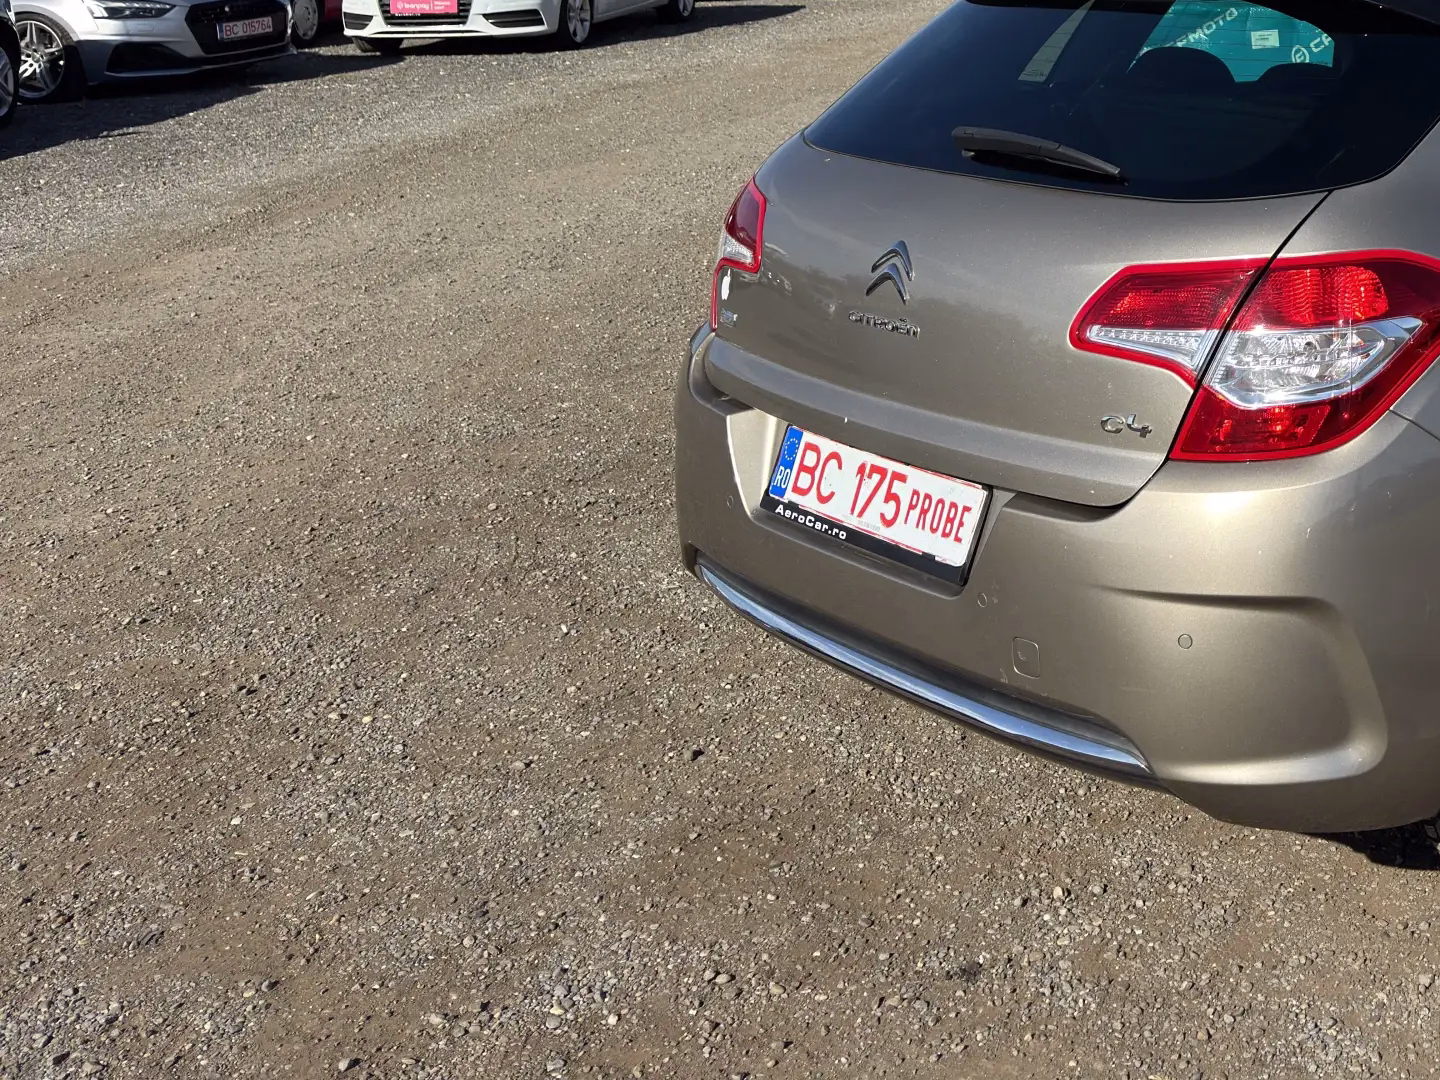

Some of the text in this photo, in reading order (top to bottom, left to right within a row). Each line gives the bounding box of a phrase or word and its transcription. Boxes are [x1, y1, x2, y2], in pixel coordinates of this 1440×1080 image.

[224, 19, 272, 37] BC 015764
[1100, 413, 1153, 439] C4
[773, 441, 973, 544] RO BC 175 PROBE
[775, 504, 847, 541] AeroCar.ro
